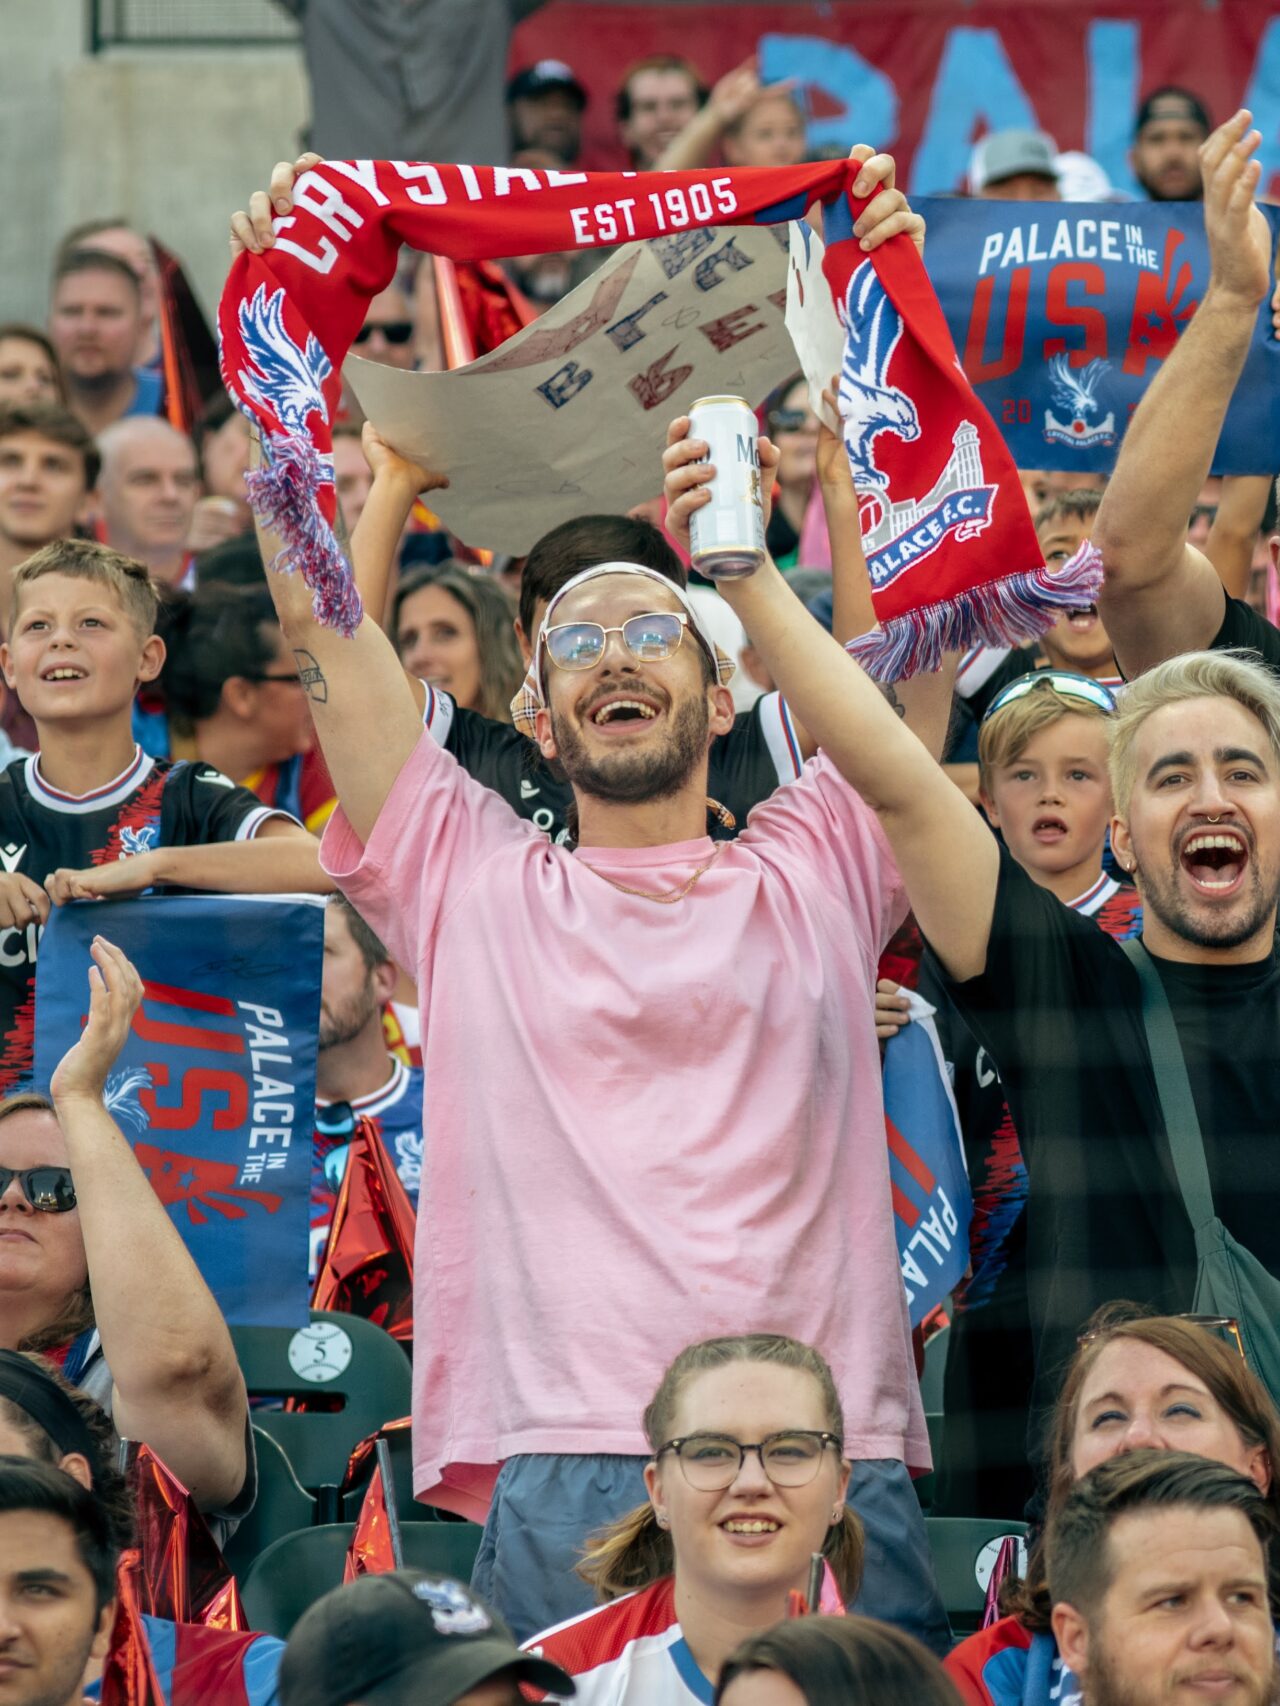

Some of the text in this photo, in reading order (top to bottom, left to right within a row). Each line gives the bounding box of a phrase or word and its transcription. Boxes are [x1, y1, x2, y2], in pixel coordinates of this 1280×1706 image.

[570, 177, 738, 245] EST 1905
[979, 219, 1123, 275] PALACE
[1125, 224, 1143, 245] IN
[1126, 244, 1160, 270] THE
[961, 227, 1198, 386] USA
[1002, 399, 1032, 424] 20
[869, 495, 981, 584] ALACE F.C.
[238, 1000, 295, 1148] PALACE
[240, 1153, 266, 1185] THE
[265, 1153, 287, 1169] IN
[313, 1340, 326, 1364] 5
